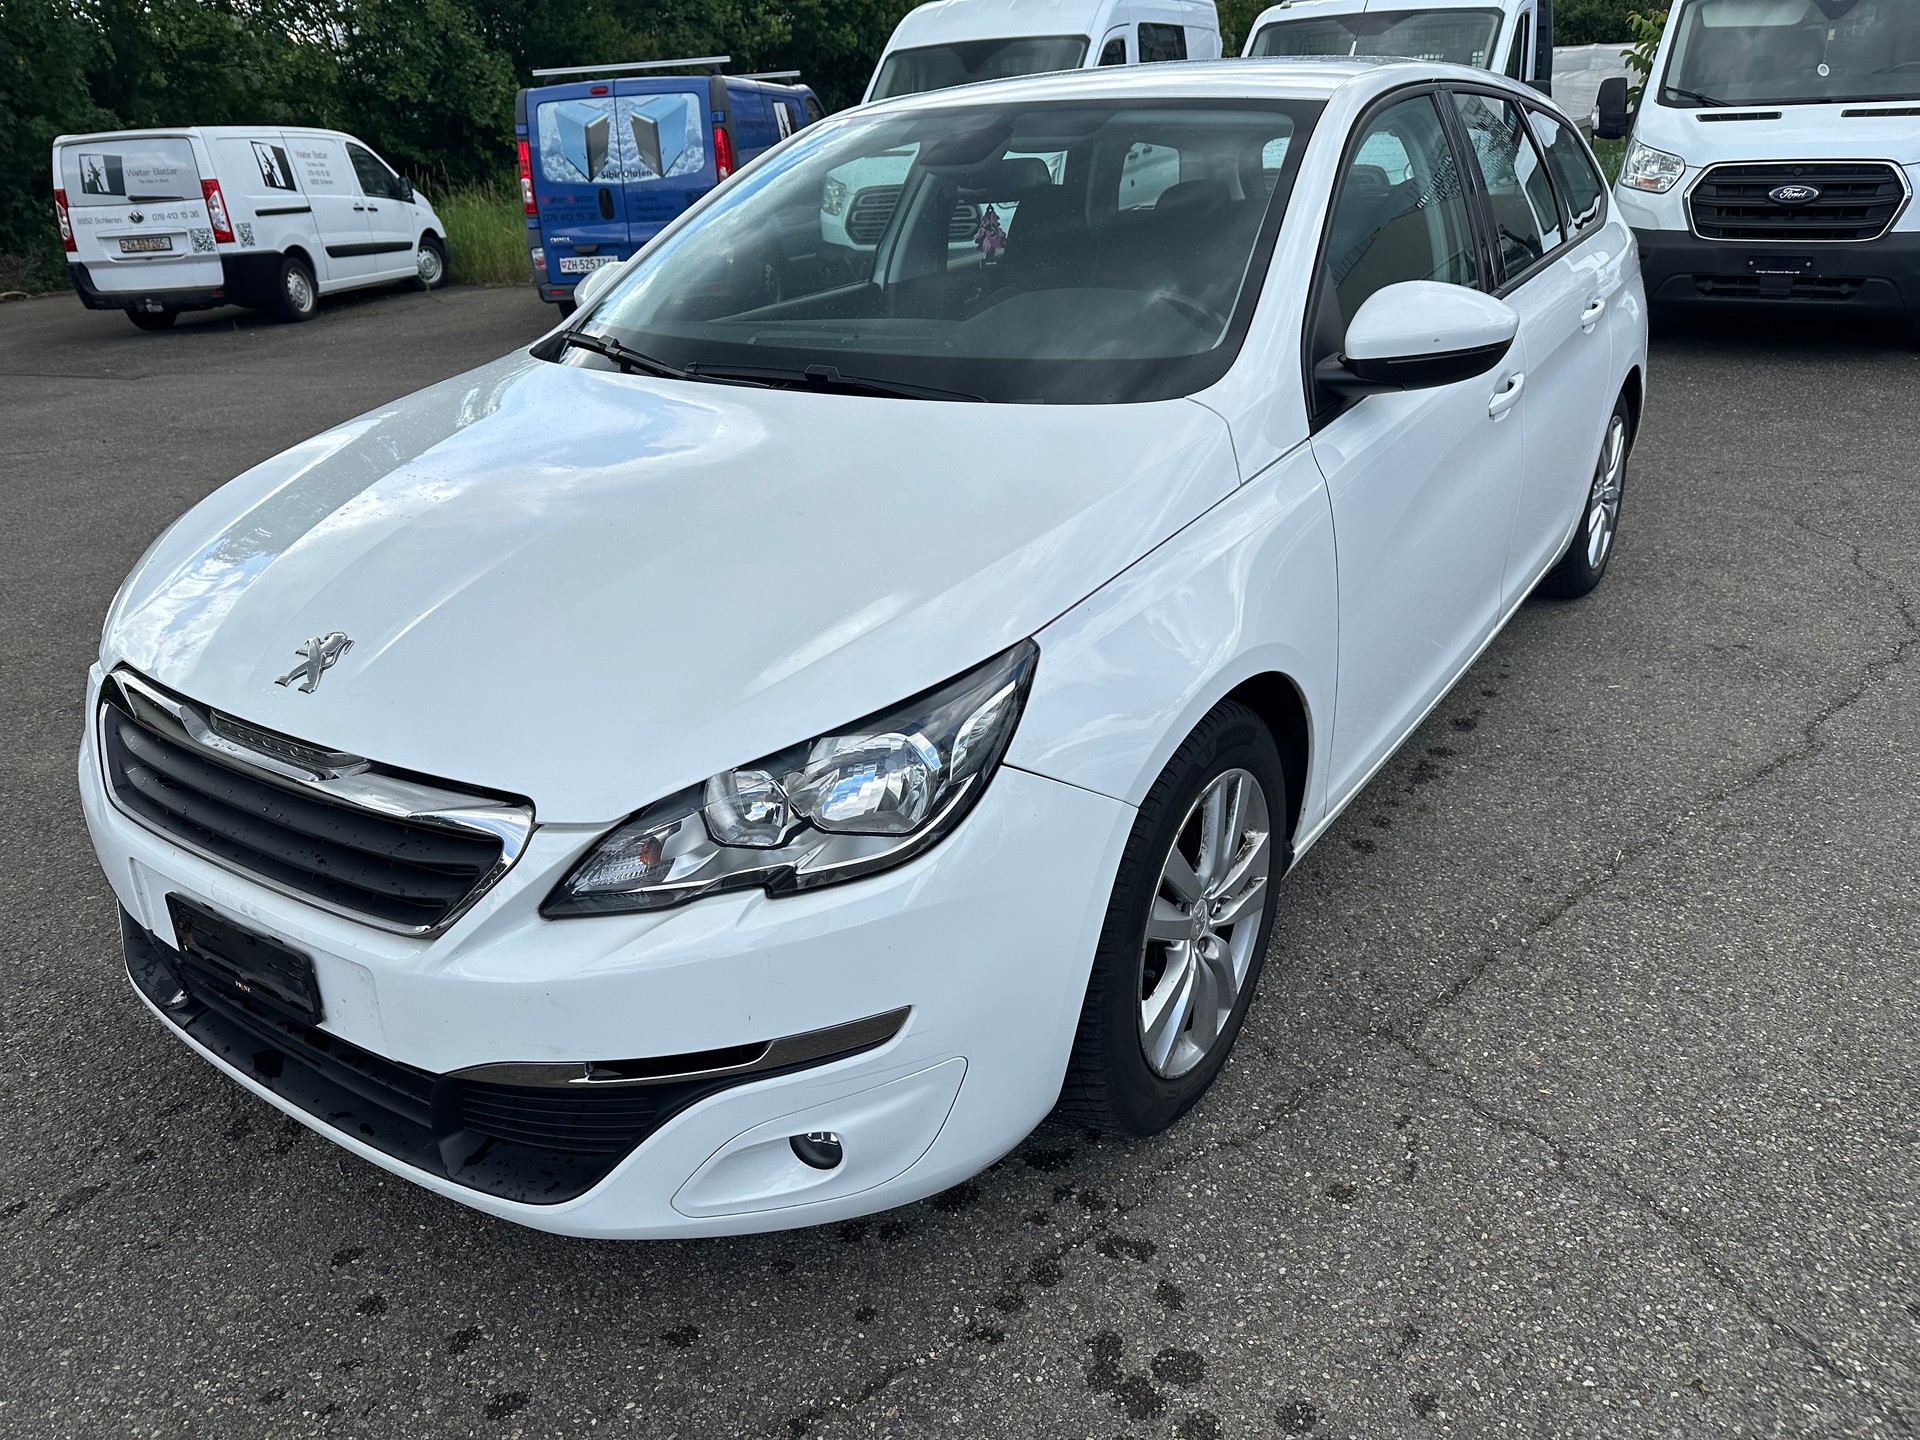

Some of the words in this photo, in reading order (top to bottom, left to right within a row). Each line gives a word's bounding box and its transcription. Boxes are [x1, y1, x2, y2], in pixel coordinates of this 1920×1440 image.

[126, 168, 151, 177] Walter
[152, 167, 178, 176] Blatter
[602, 170, 620, 181] Sibir
[1779, 187, 1808, 199] Ford
[152, 212, 165, 222] 079
[167, 211, 179, 220] 413
[180, 211, 188, 219] 15
